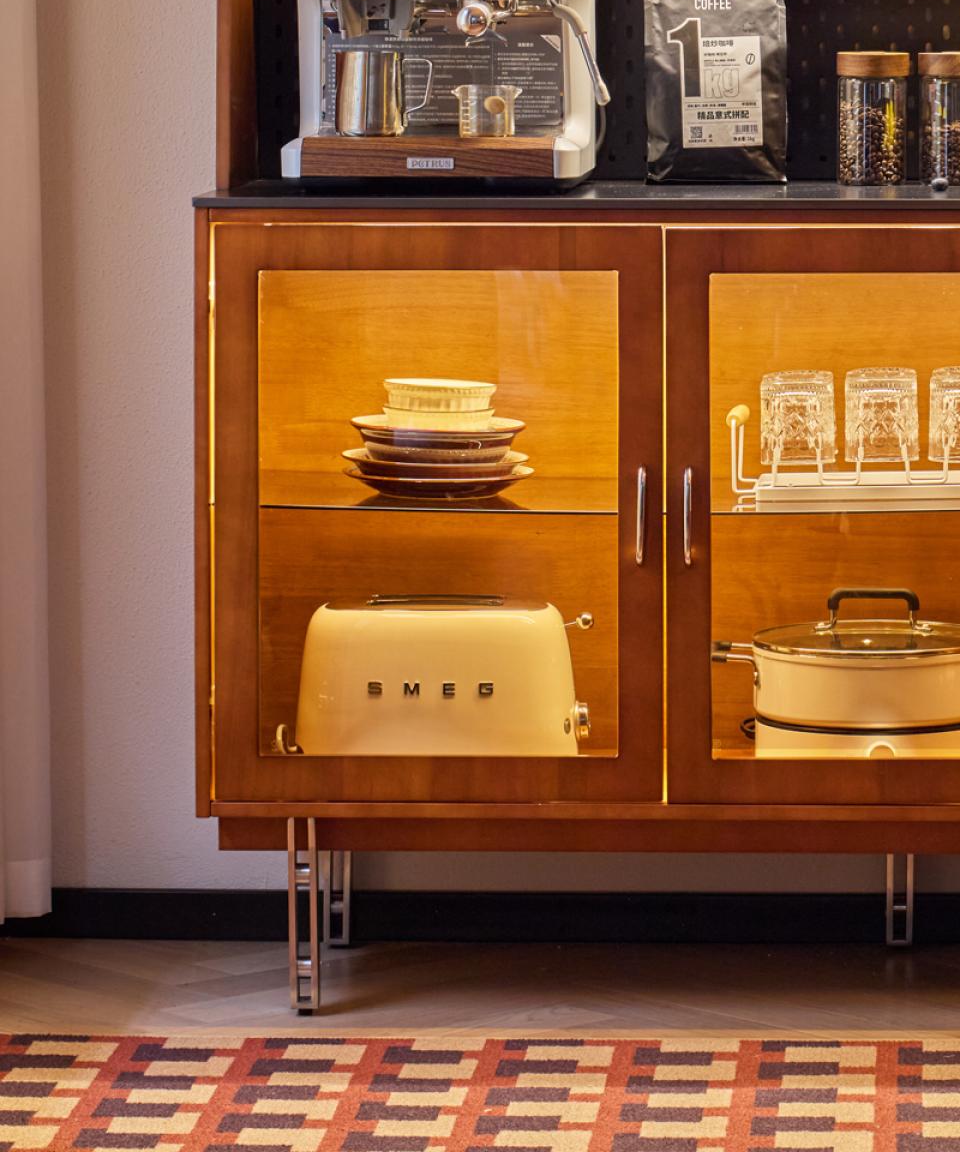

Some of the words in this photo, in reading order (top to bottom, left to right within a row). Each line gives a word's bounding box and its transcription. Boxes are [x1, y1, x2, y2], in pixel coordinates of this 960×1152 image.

[697, 110, 750, 120] 精品意式拼配
[367, 681, 494, 696] SMEG
